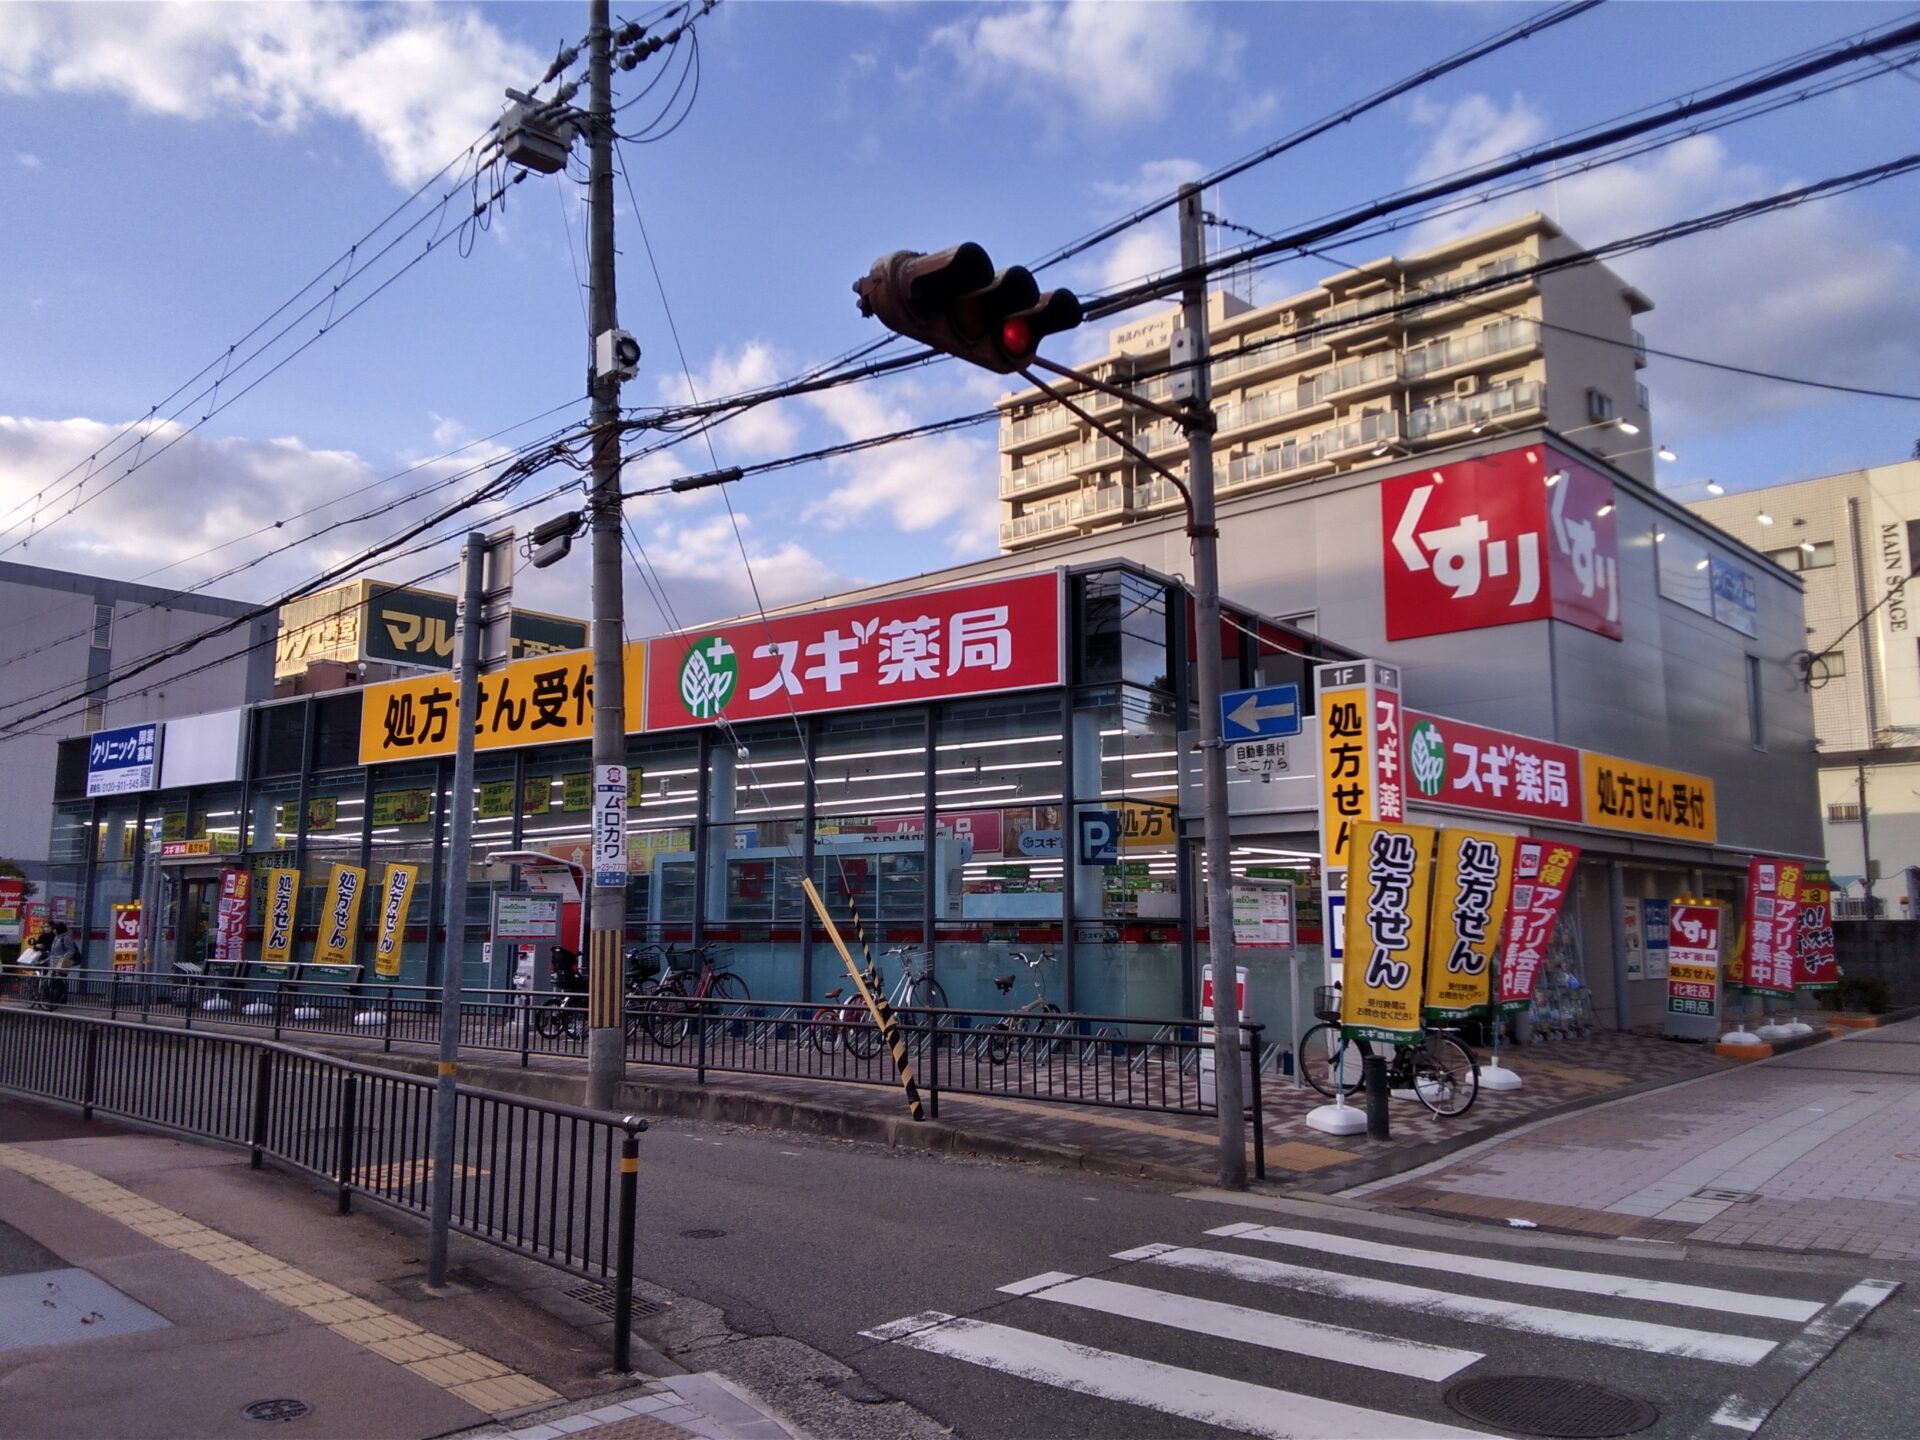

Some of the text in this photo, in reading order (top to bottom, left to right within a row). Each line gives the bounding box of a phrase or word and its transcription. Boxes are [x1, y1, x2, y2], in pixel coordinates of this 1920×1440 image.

[1392, 485, 1540, 606] くすり
[1551, 469, 1618, 622] くすり
[1882, 523, 1908, 632] MAIN STAGE
[749, 605, 1012, 700] スギ薬局
[1334, 669, 1353, 685] 1F
[1379, 669, 1391, 685] 1F
[92, 737, 137, 765] クリニック
[1238, 758, 1288, 772] ここから
[1453, 742, 1569, 808] スギ薬局
[604, 795, 621, 859] ムロカワ
[1598, 766, 1705, 829] 処方せん受付
[1084, 821, 1110, 858] P
[268, 873, 293, 948] 処方せん
[328, 870, 357, 948] 処方せん
[380, 870, 407, 952] 処方せん
[1366, 832, 1416, 989] 処方せん
[1448, 838, 1499, 973] 処方せん
[1672, 908, 1717, 948] くすり
[1670, 951, 1716, 962] スギ薬局
[1670, 966, 1716, 980] 処方せん
[1751, 920, 1773, 983] 募集中
[1673, 983, 1711, 998] 化粧品
[1673, 999, 1709, 1014] 日用品
